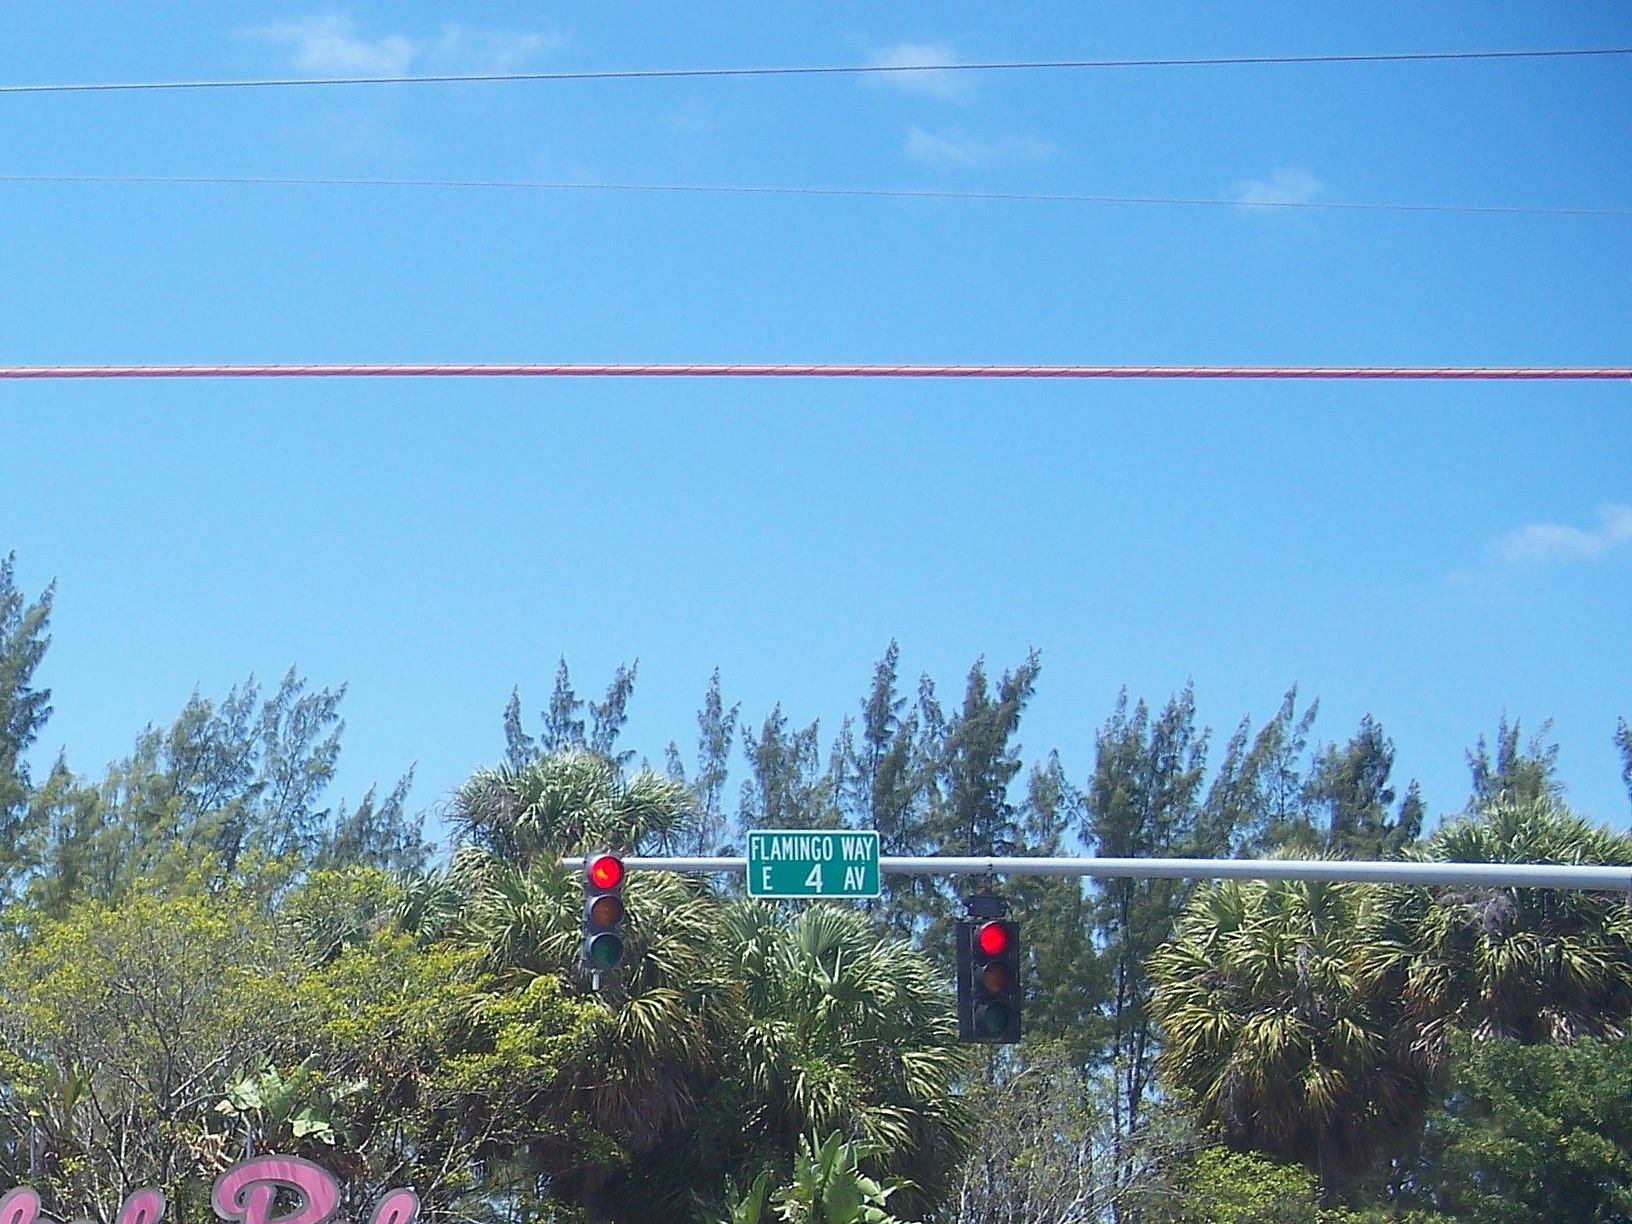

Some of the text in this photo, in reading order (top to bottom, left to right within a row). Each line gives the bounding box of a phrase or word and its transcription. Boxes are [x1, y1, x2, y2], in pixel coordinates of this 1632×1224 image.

[751, 836, 874, 861] FLAMINGO WAY
[762, 863, 866, 893] E 4 AV
